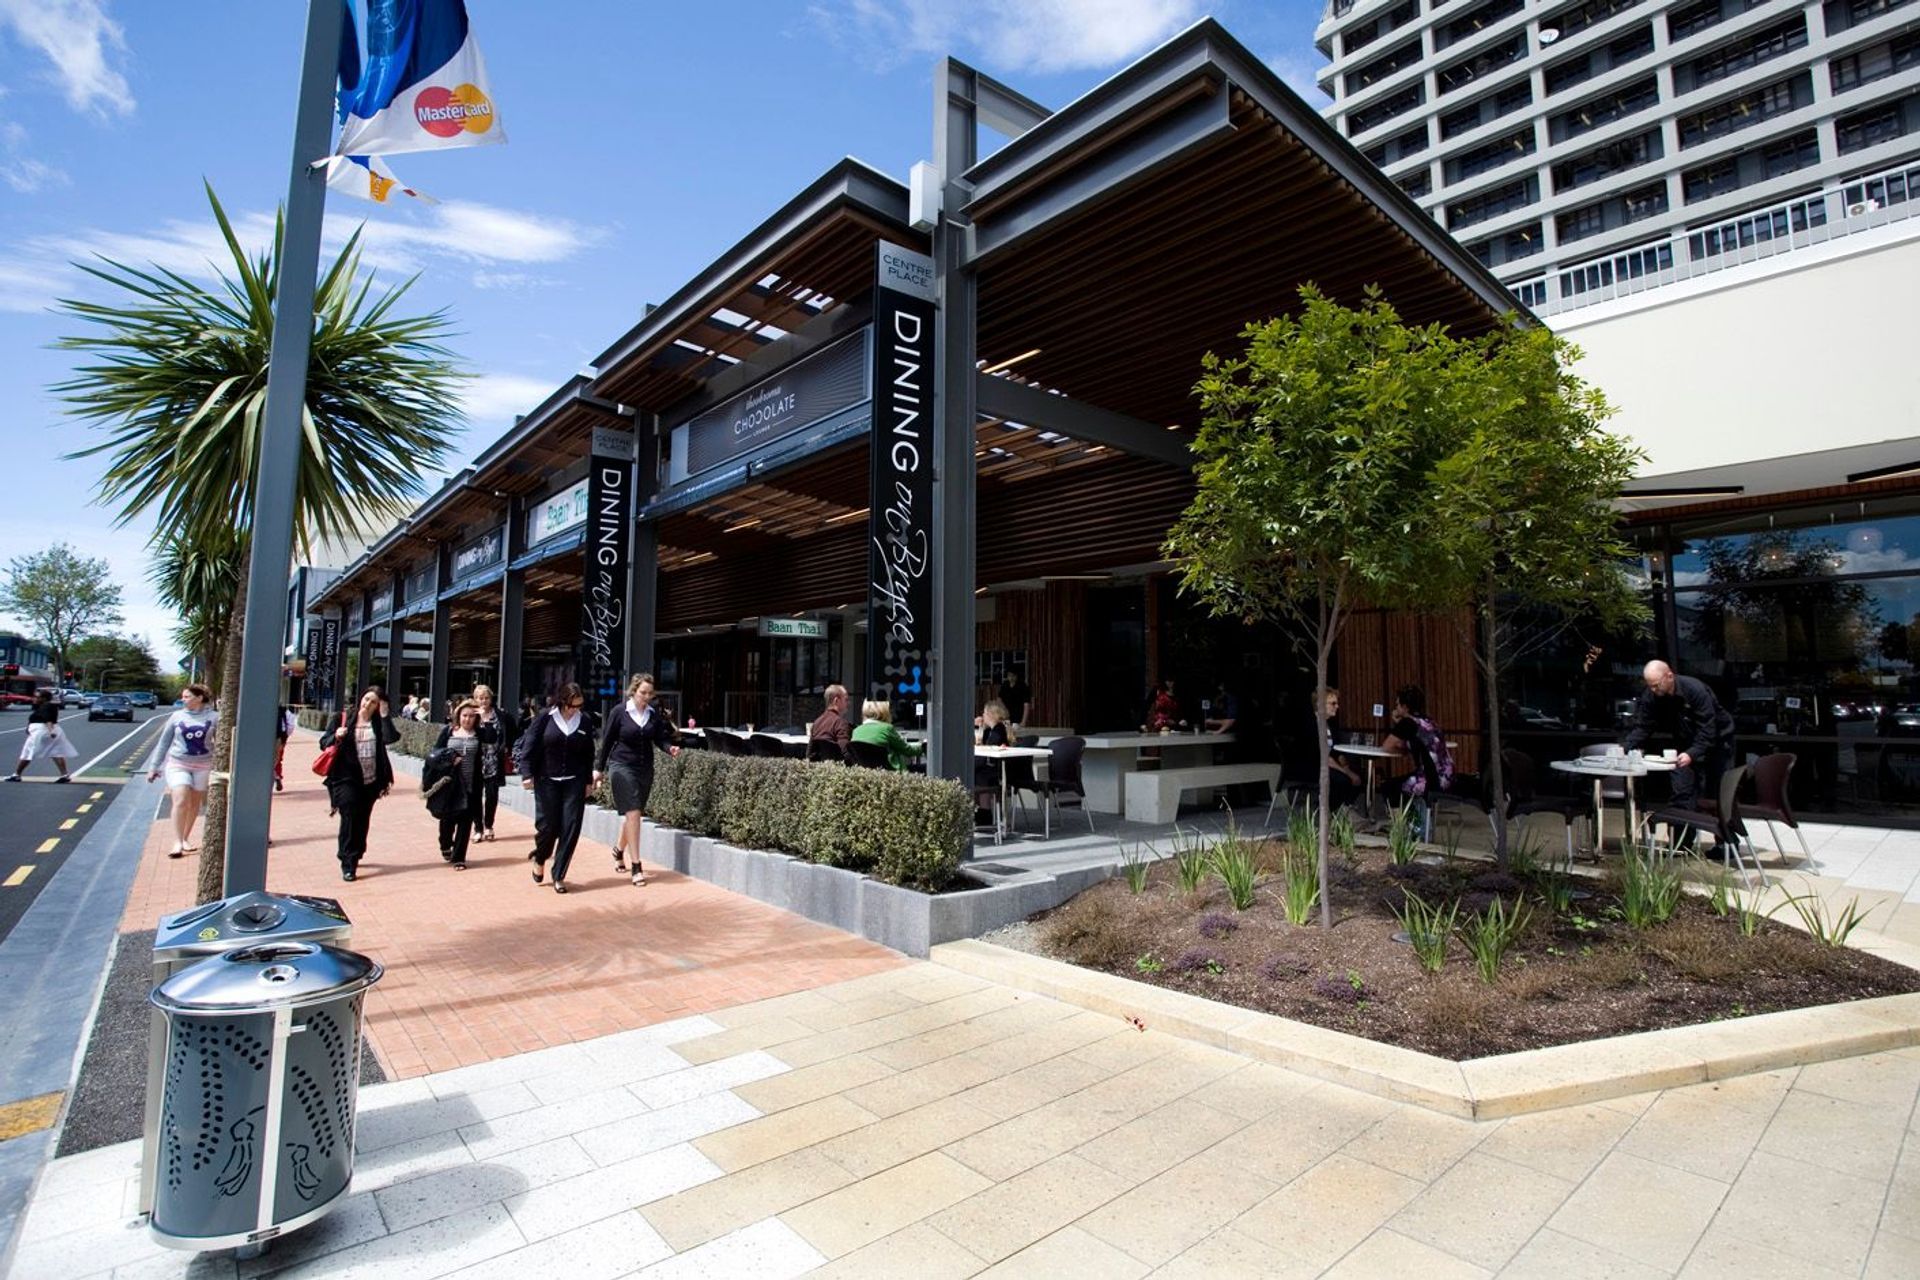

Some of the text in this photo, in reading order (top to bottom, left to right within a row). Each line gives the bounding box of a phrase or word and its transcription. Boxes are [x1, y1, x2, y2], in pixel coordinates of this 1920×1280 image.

[417, 101, 491, 122] MasterCard
[883, 254, 933, 278] CENTRE
[888, 266, 928, 288] PLACE
[872, 310, 928, 643] DINING on Bryce
[582, 468, 622, 667] DINING on Bryce
[767, 620, 822, 635] Baan Thai
